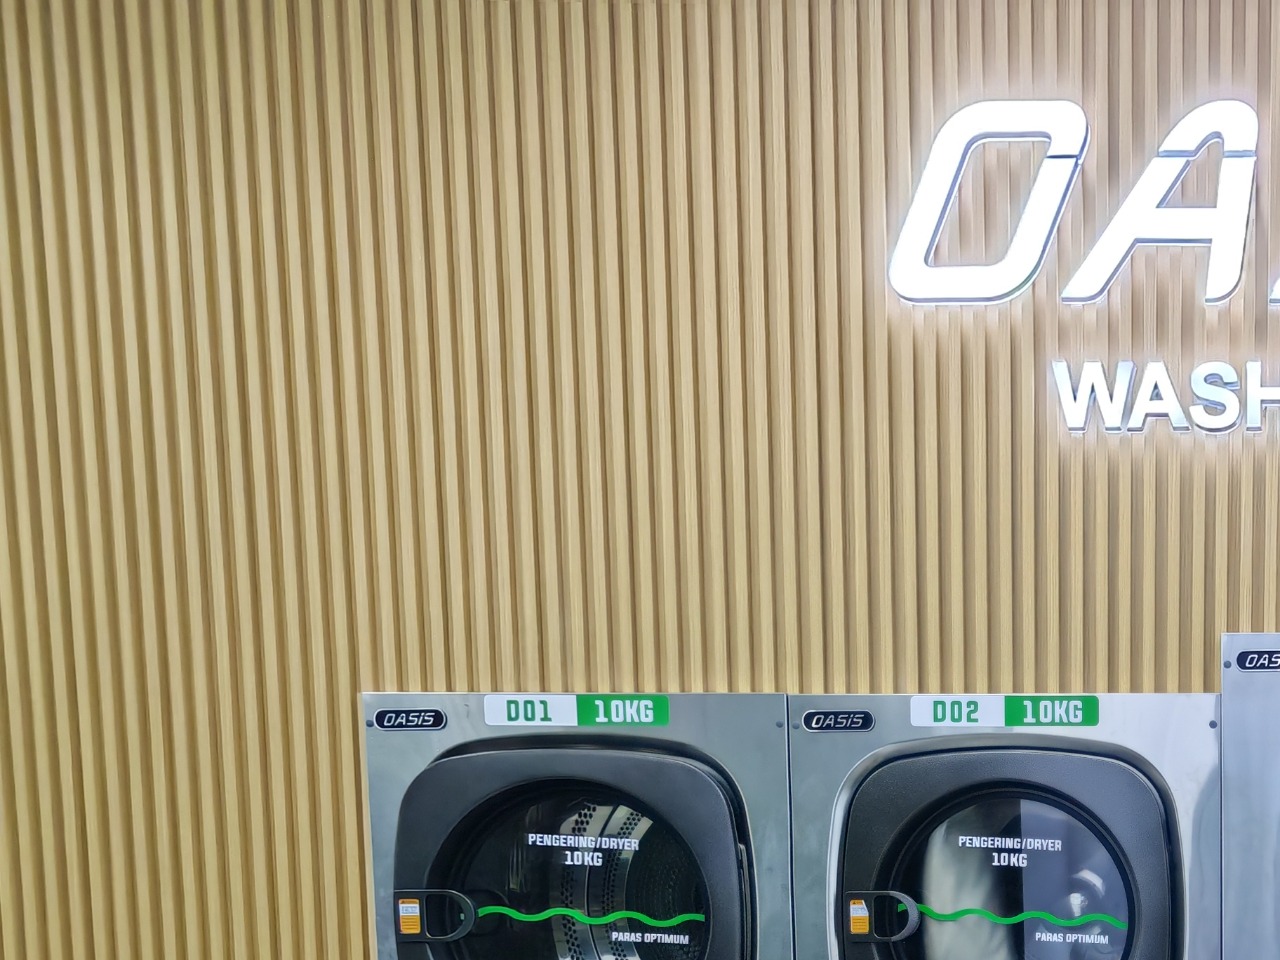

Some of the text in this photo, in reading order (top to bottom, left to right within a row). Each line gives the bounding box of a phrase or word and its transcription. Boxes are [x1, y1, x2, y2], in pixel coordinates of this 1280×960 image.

[506, 699, 654, 723] D01 10KG
[932, 700, 1083, 724] D02 10KG
[528, 833, 640, 851] PENGERING/DRYER
[958, 835, 1062, 852] PENGERING/DRYER
[564, 851, 603, 867] 10KG
[991, 852, 1028, 868] 10KG
[612, 931, 690, 945] PARAS OPTIMUM
[1035, 931, 1109, 945] PARAS OPTIMUM
